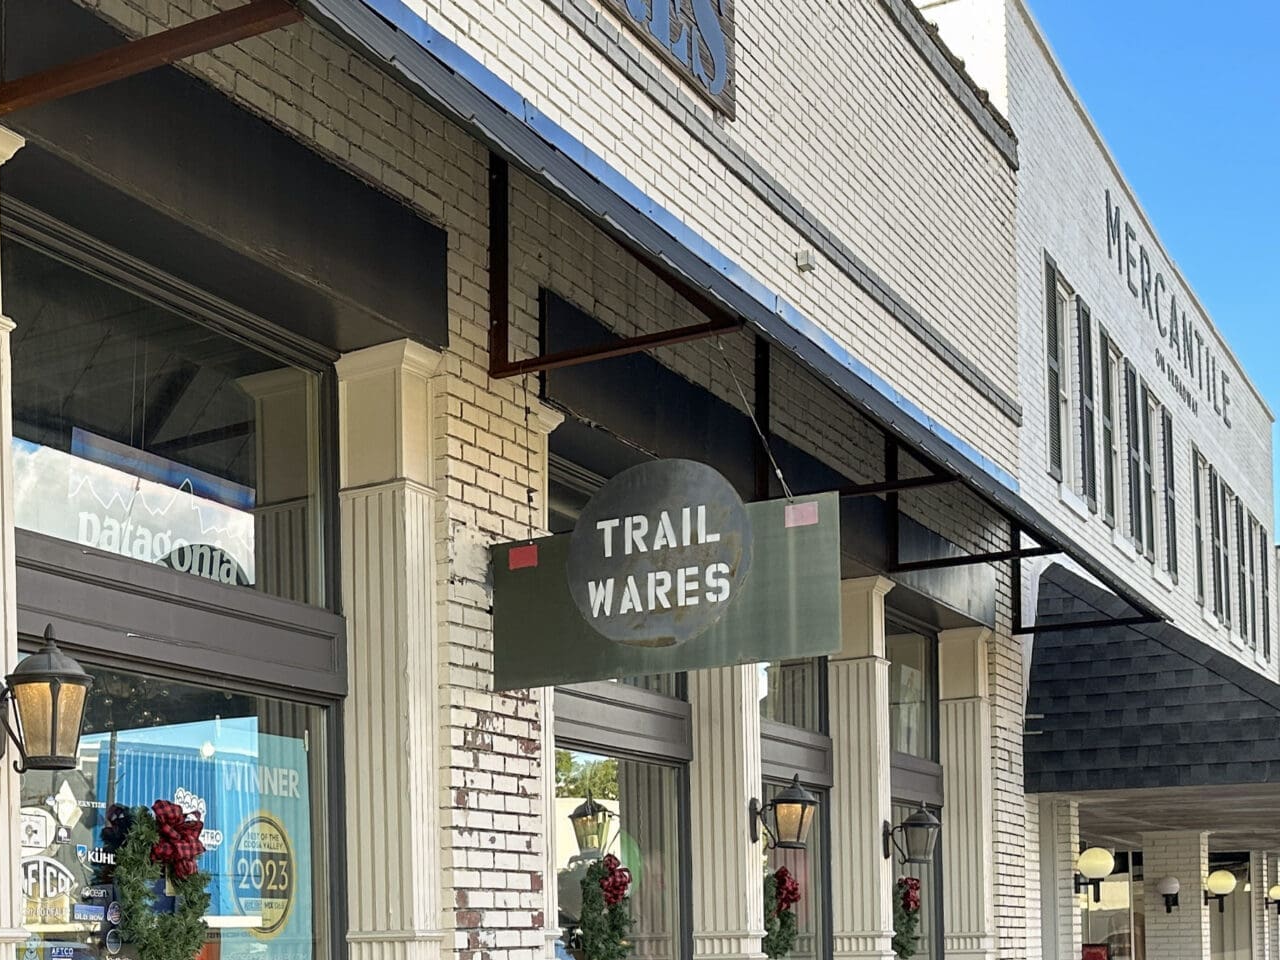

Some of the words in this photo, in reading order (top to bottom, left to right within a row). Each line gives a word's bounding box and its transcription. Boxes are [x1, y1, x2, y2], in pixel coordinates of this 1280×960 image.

[1105, 188, 1232, 430] MERCANTILE
[78, 510, 239, 587] patagonia
[596, 505, 720, 558] TRAIL
[588, 563, 730, 618] WARES
[223, 765, 301, 799] WINNER
[237, 857, 289, 891] 2023
